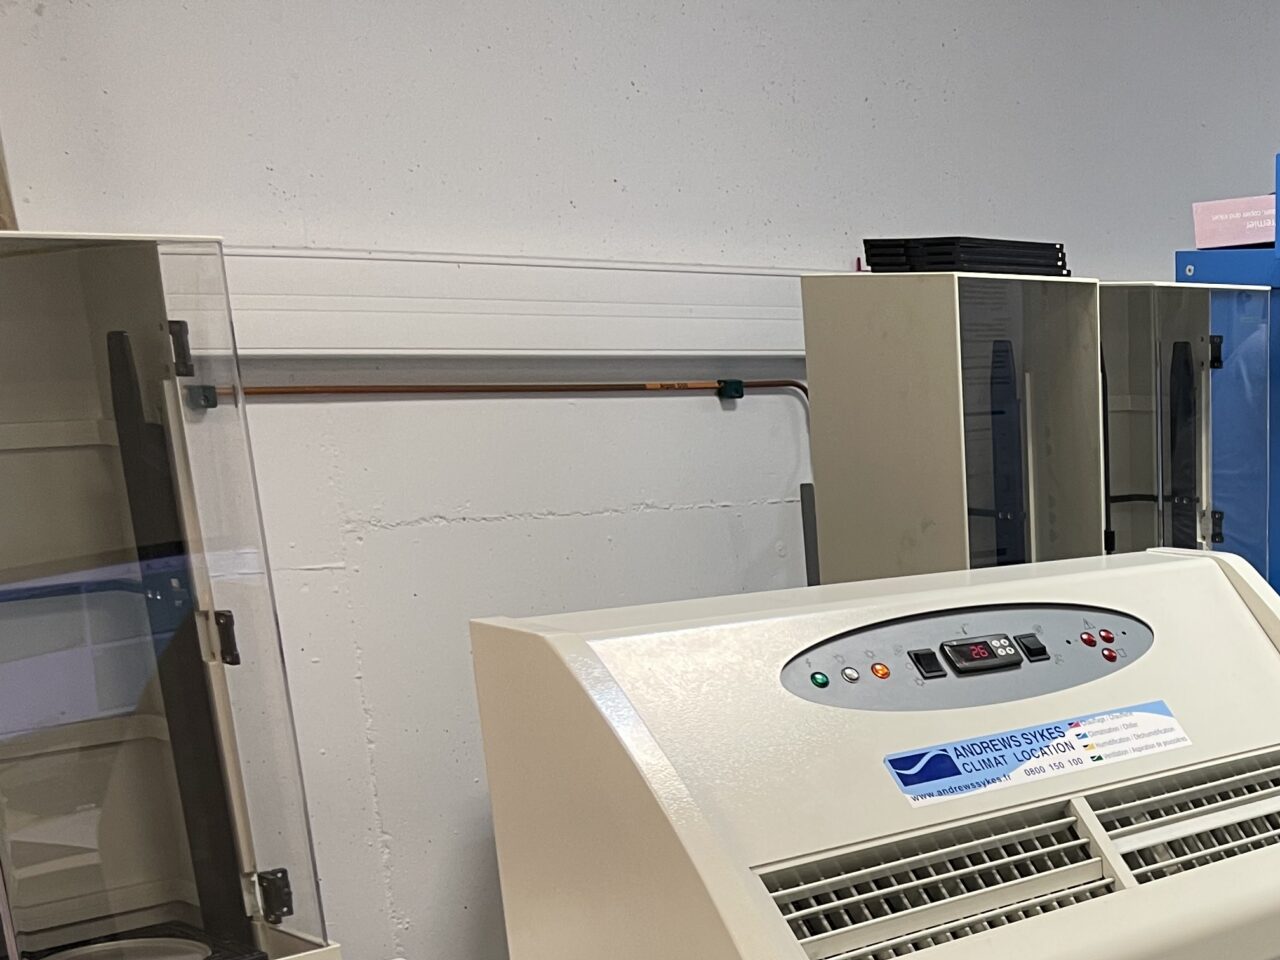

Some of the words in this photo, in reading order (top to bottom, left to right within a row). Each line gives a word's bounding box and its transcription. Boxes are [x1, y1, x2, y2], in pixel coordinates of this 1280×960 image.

[1247, 218, 1276, 229] remier
[969, 645, 988, 658] 26
[953, 735, 1021, 759] ANDREWS
[1022, 726, 1066, 746] SYKES
[961, 755, 1009, 774] CLIMAT
[1013, 740, 1075, 762] LOCATION
[1024, 765, 1046, 777] 0800
[1049, 760, 1065, 771] 150
[1068, 757, 1083, 767] 100
[911, 773, 1012, 802] www.andrewssykes.fr
